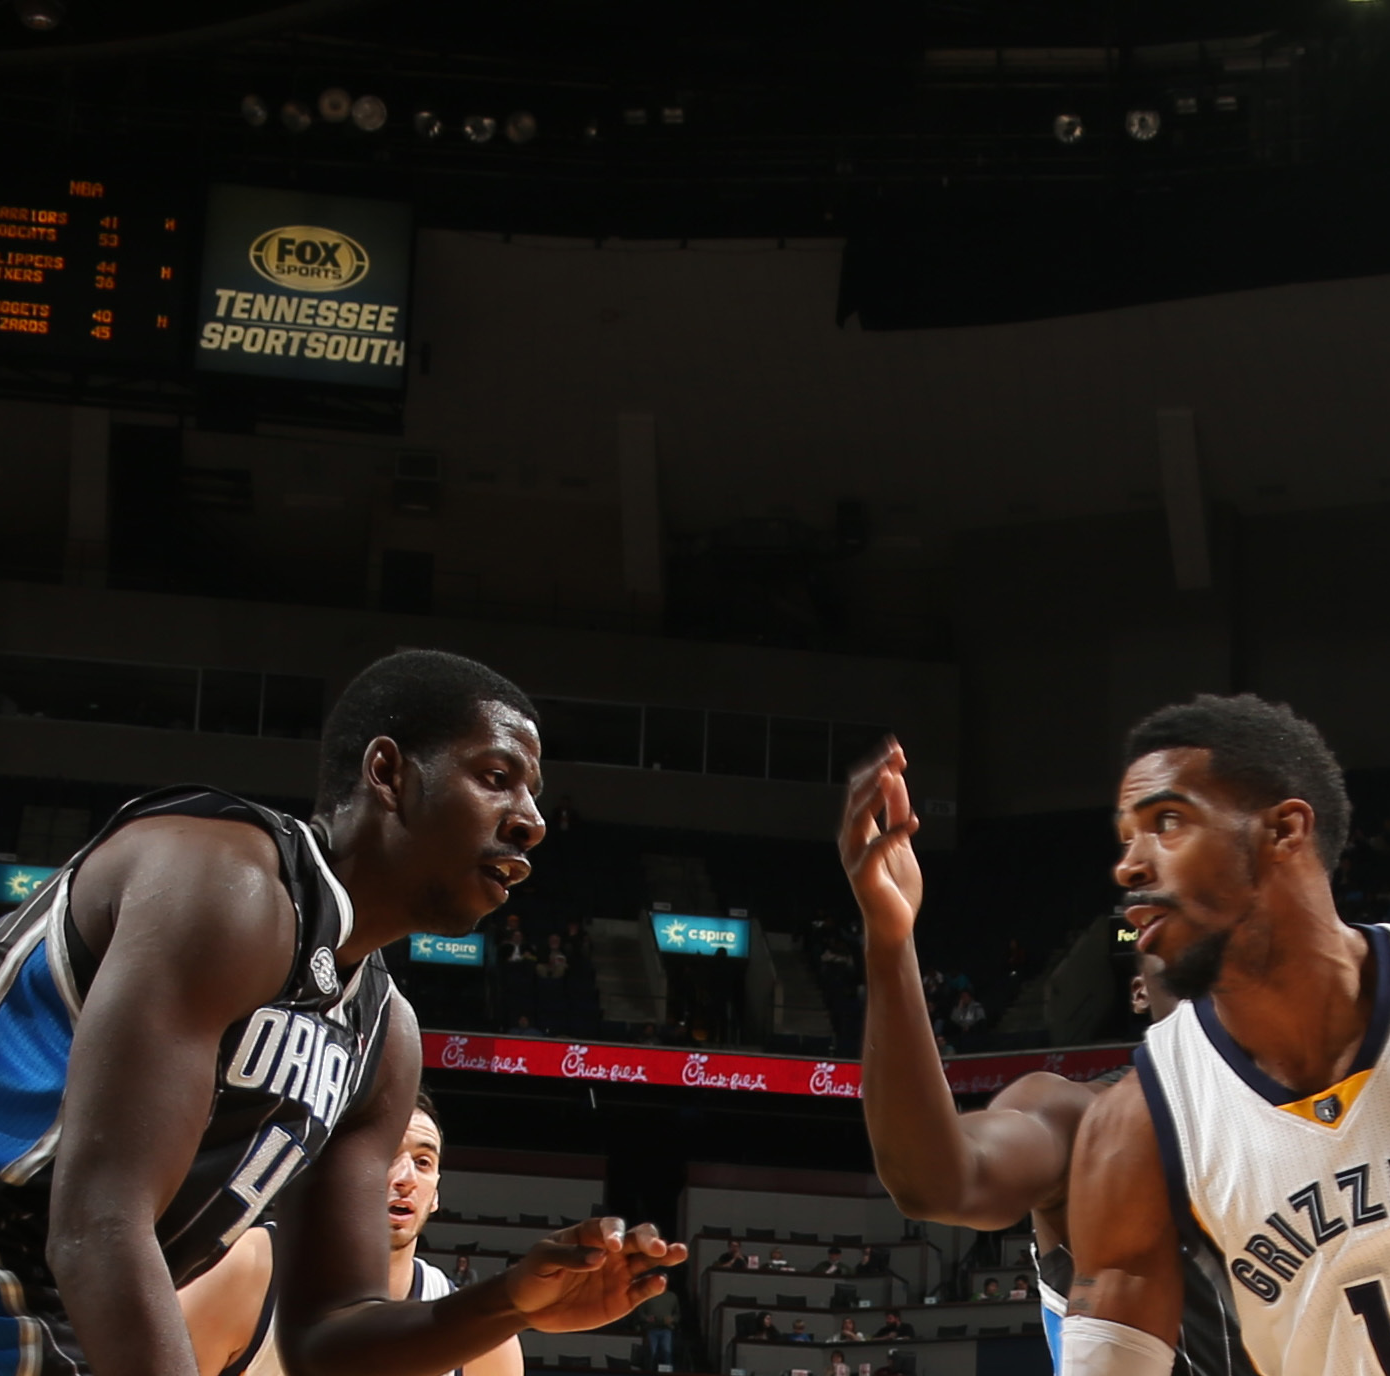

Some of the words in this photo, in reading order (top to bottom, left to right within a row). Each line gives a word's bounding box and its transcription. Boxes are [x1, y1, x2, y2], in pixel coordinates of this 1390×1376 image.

[70, 180, 104, 198] NBA
[277, 237, 342, 267] FOX
[274, 263, 342, 280] SPORTS
[215, 288, 399, 333] TENNESSEE
[200, 321, 406, 366] SPORTSOUTH
[809, 1061, 862, 1098] Chick-
